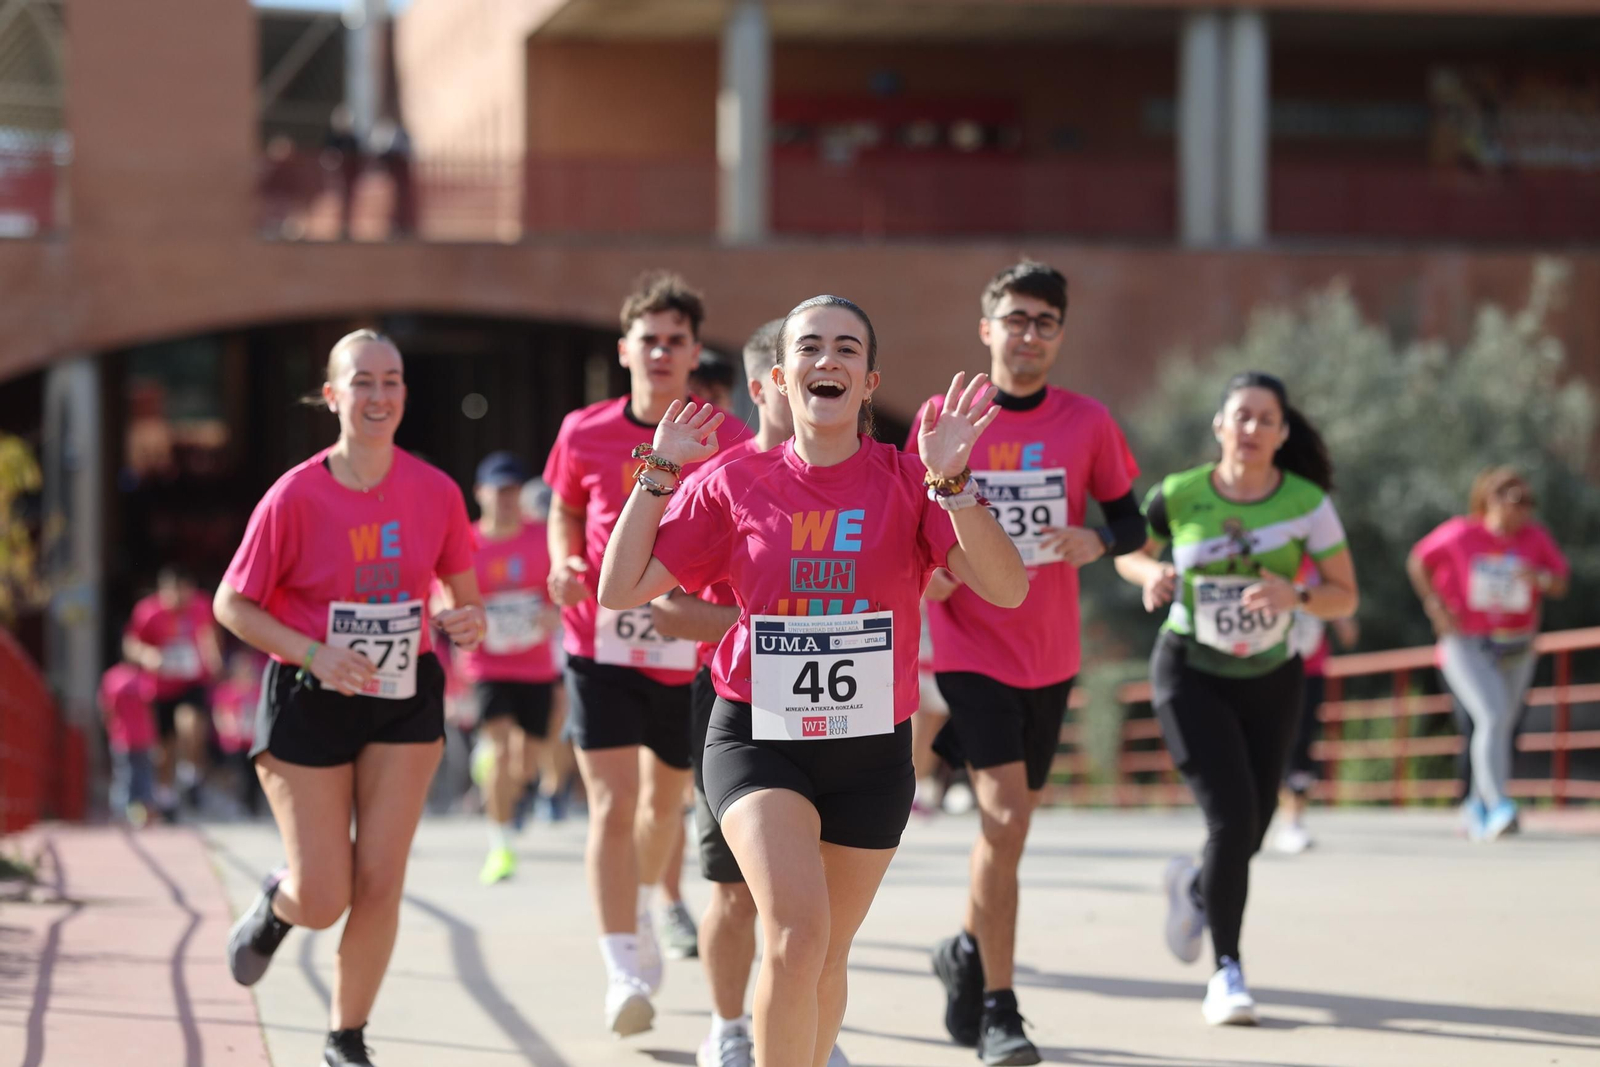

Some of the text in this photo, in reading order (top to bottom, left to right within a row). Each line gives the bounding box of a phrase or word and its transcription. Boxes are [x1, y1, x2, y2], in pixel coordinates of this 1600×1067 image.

[988, 441, 1044, 471] WE
[348, 520, 401, 561] WE
[791, 508, 865, 552] WE
[795, 561, 852, 590] RUN
[335, 619, 383, 635] UMA
[616, 611, 677, 642] 62
[1215, 606, 1278, 635] 680
[759, 635, 821, 652] UMA
[792, 659, 857, 703] 46
[803, 720, 827, 732] WE
[828, 715, 848, 723] RUN
[828, 728, 848, 736] RUN
